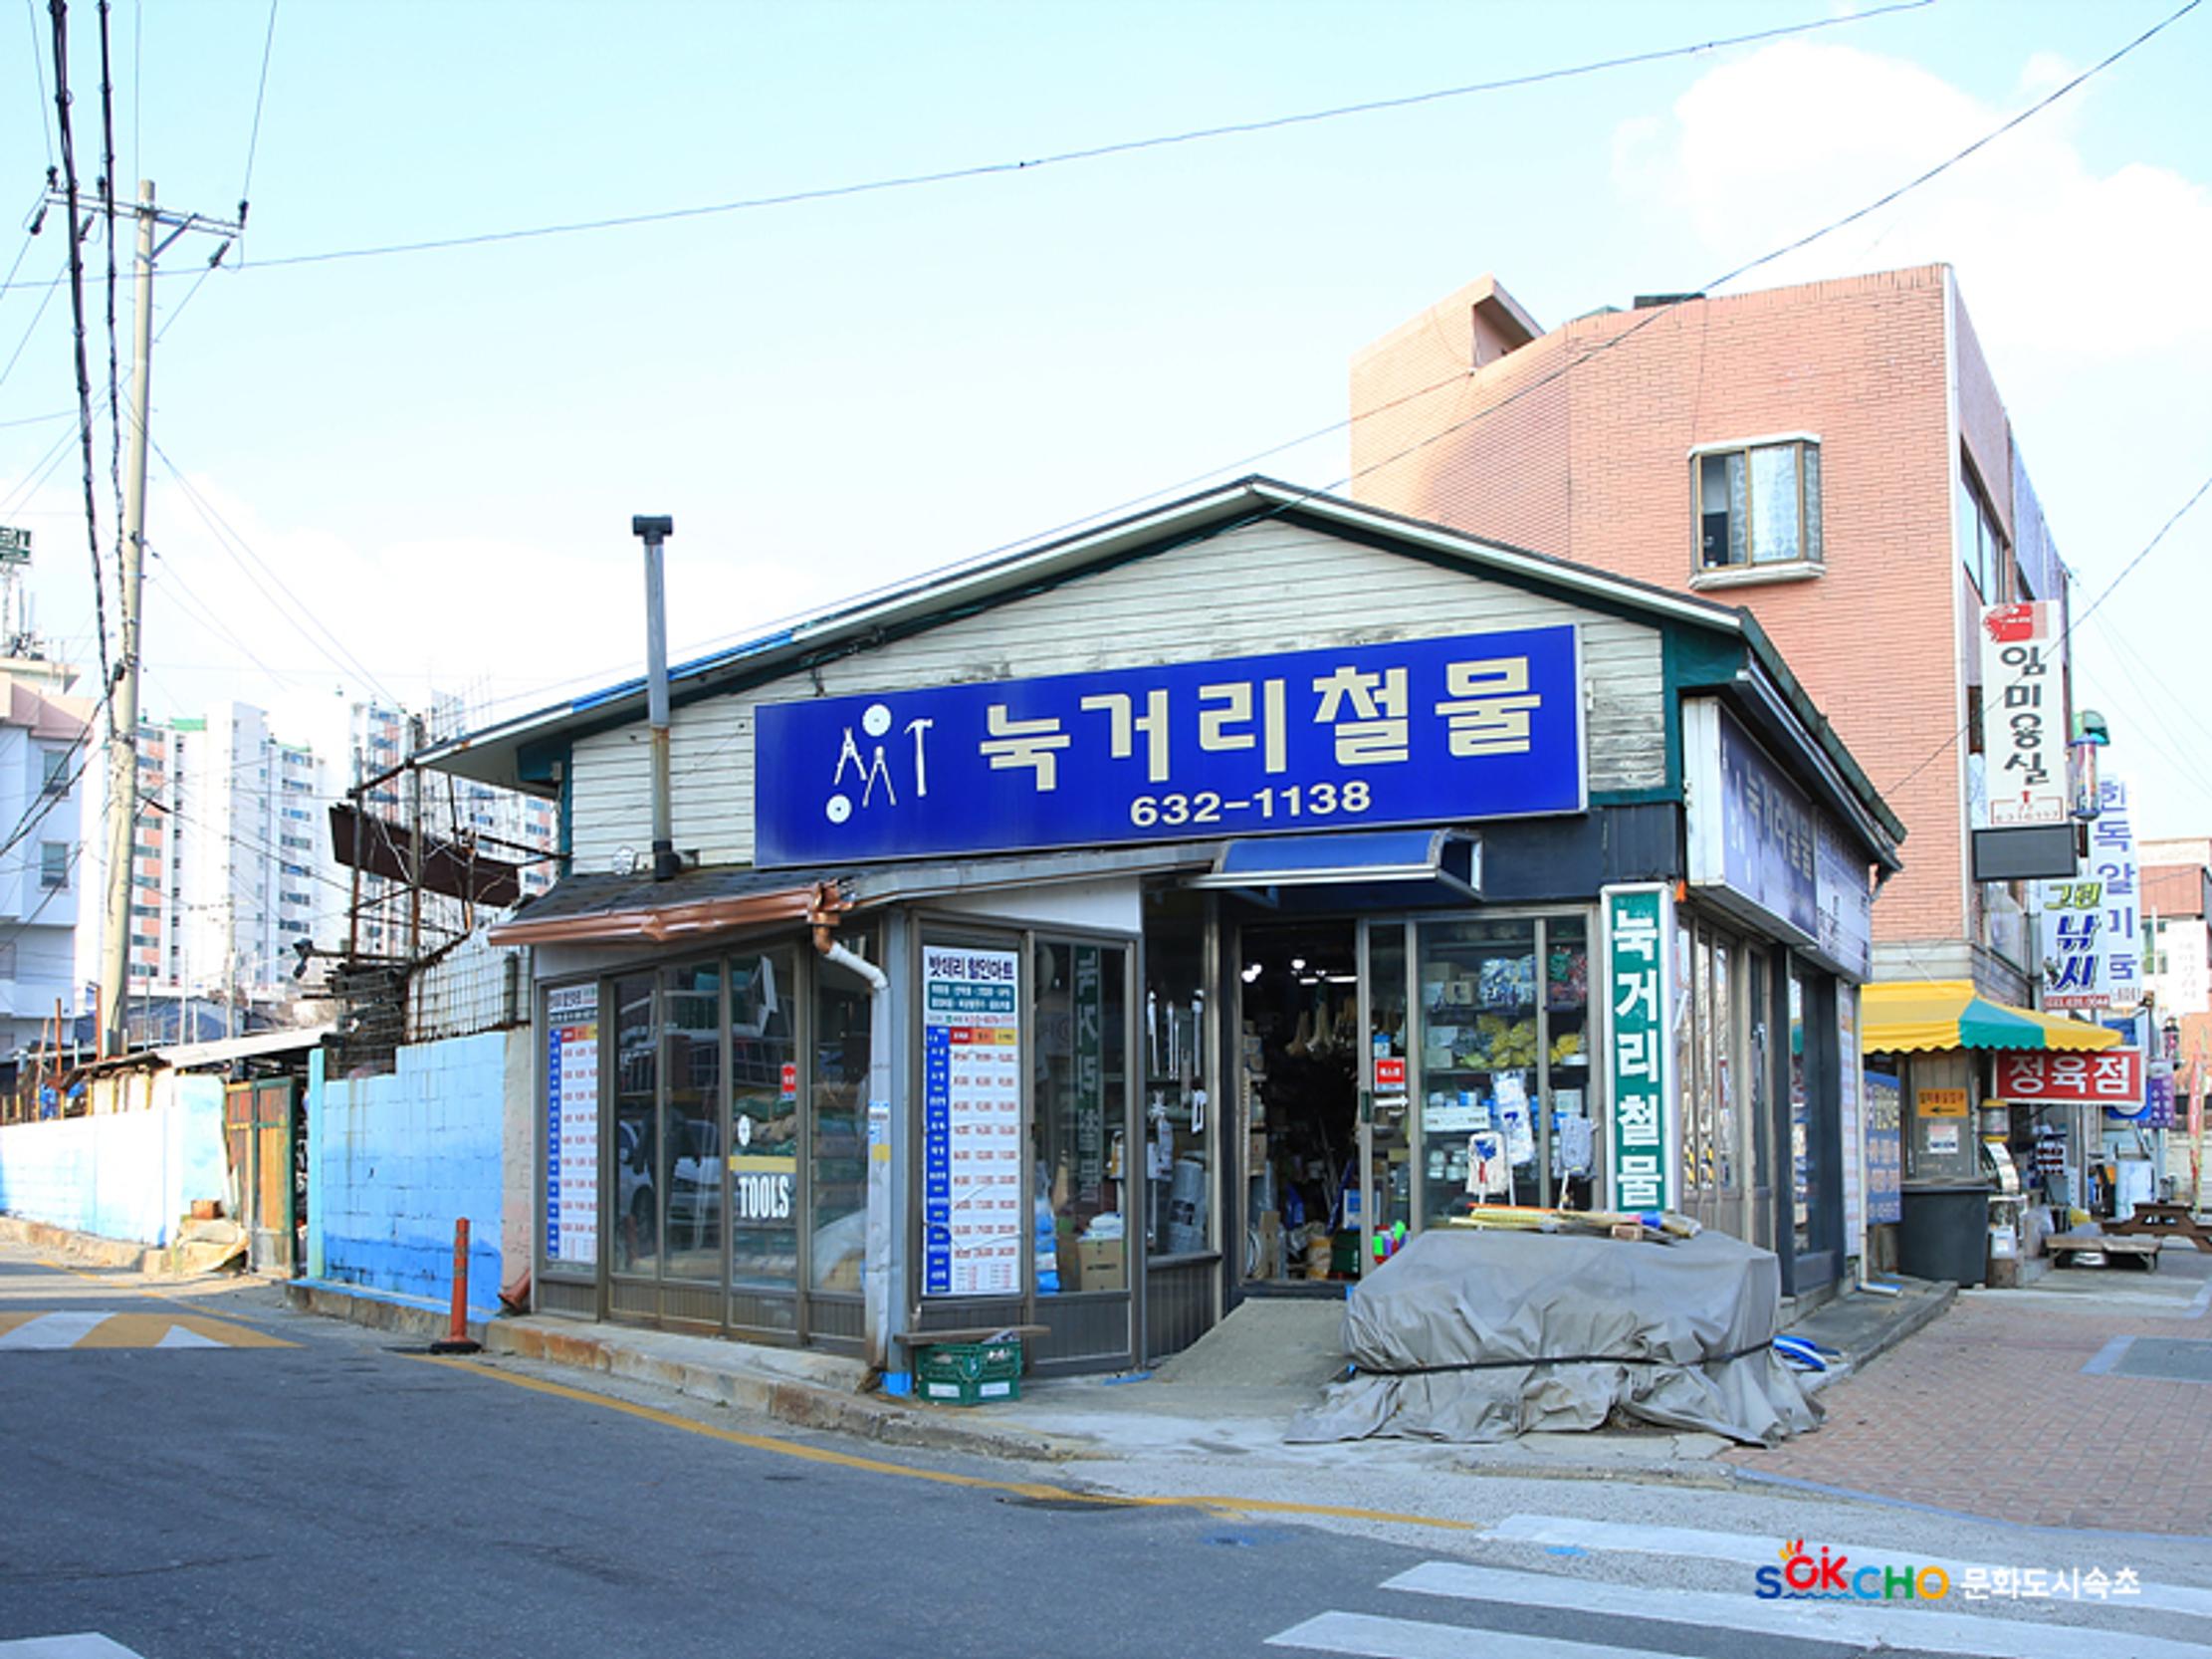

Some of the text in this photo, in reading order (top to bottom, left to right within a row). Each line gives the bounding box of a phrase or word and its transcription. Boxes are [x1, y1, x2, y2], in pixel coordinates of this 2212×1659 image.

[981, 655, 1541, 792] 눅거리철물
[1130, 780, 1371, 827] 632-1138
[2055, 914, 2101, 993] 낚시
[1613, 909, 1662, 1207] 눅거리철물
[2009, 1055, 2131, 1094] 정육점
[738, 1175, 789, 1218] TOOLS
